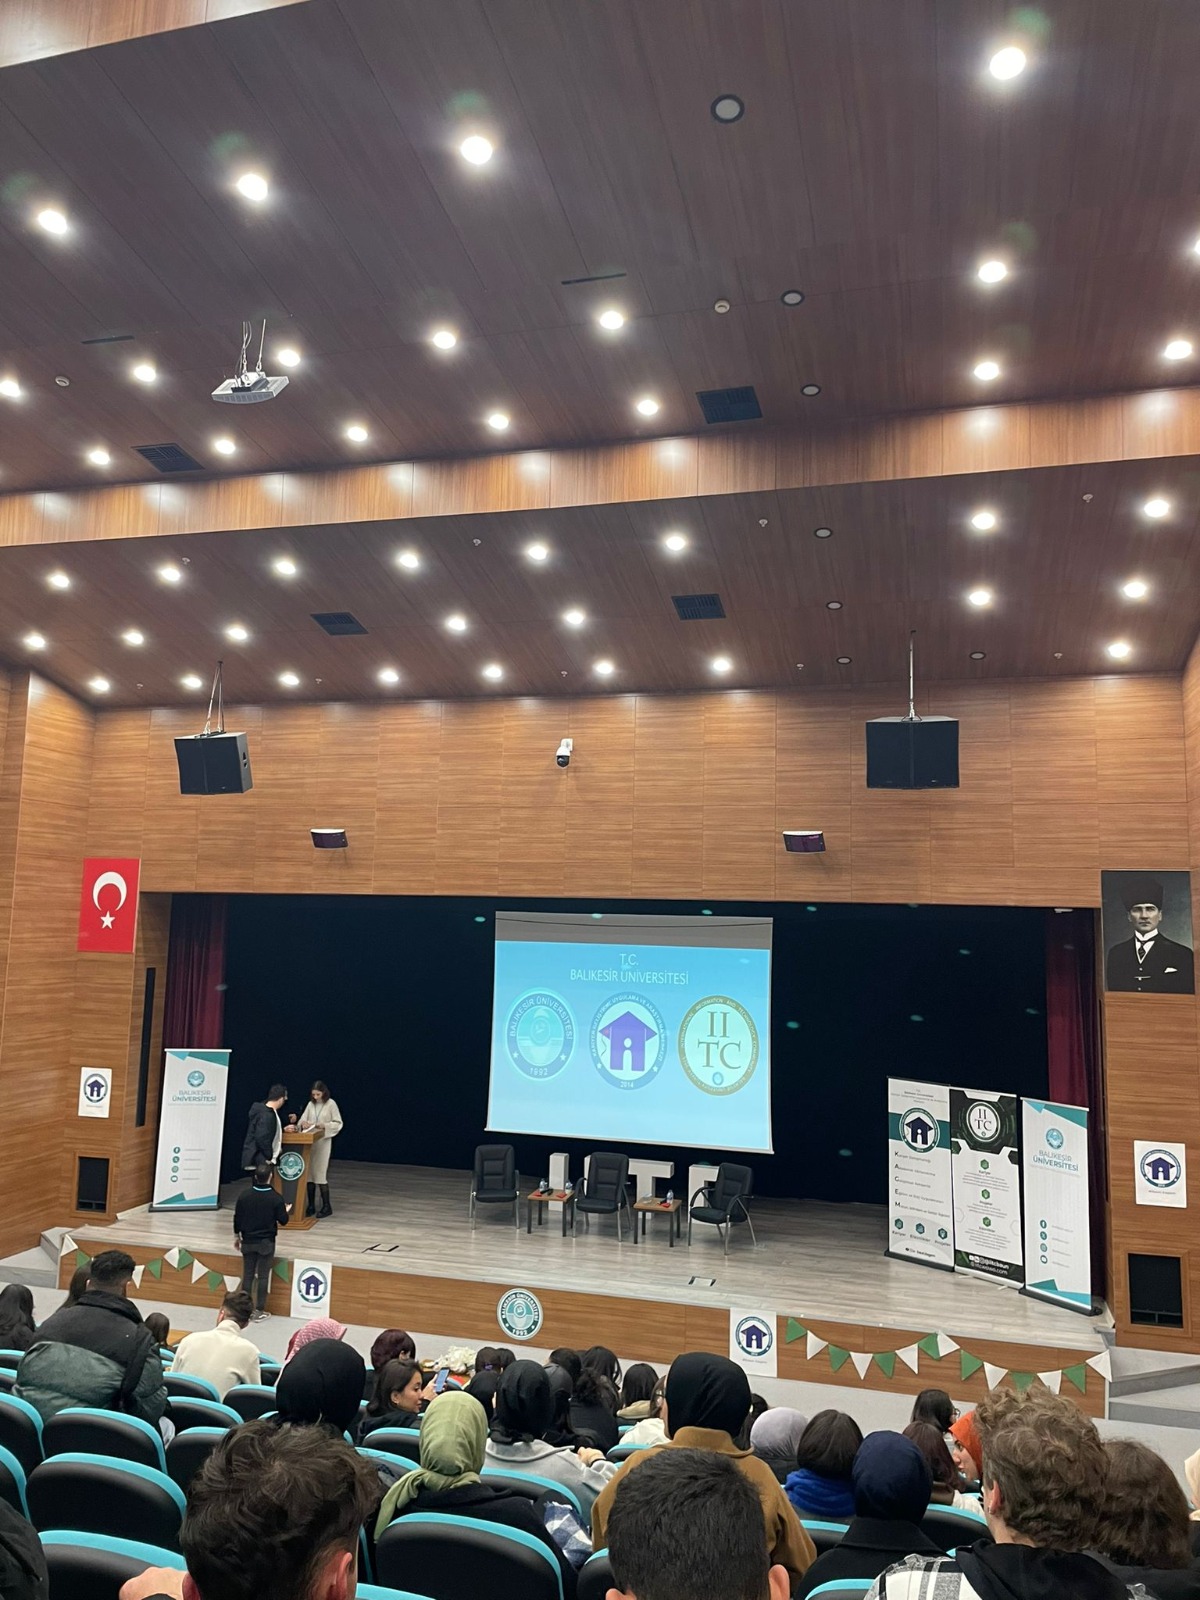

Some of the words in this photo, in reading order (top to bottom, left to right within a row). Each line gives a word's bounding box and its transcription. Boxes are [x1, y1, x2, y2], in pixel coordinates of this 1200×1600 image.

[619, 953, 639, 966] T.C.
[570, 968, 618, 982] BALIKESİR
[697, 1039, 742, 1070] TC
[974, 1118, 992, 1132] TC
[1038, 1149, 1072, 1162] BALIKESİR
[1032, 1154, 1079, 1172] ÜNİVERSİTESİ
